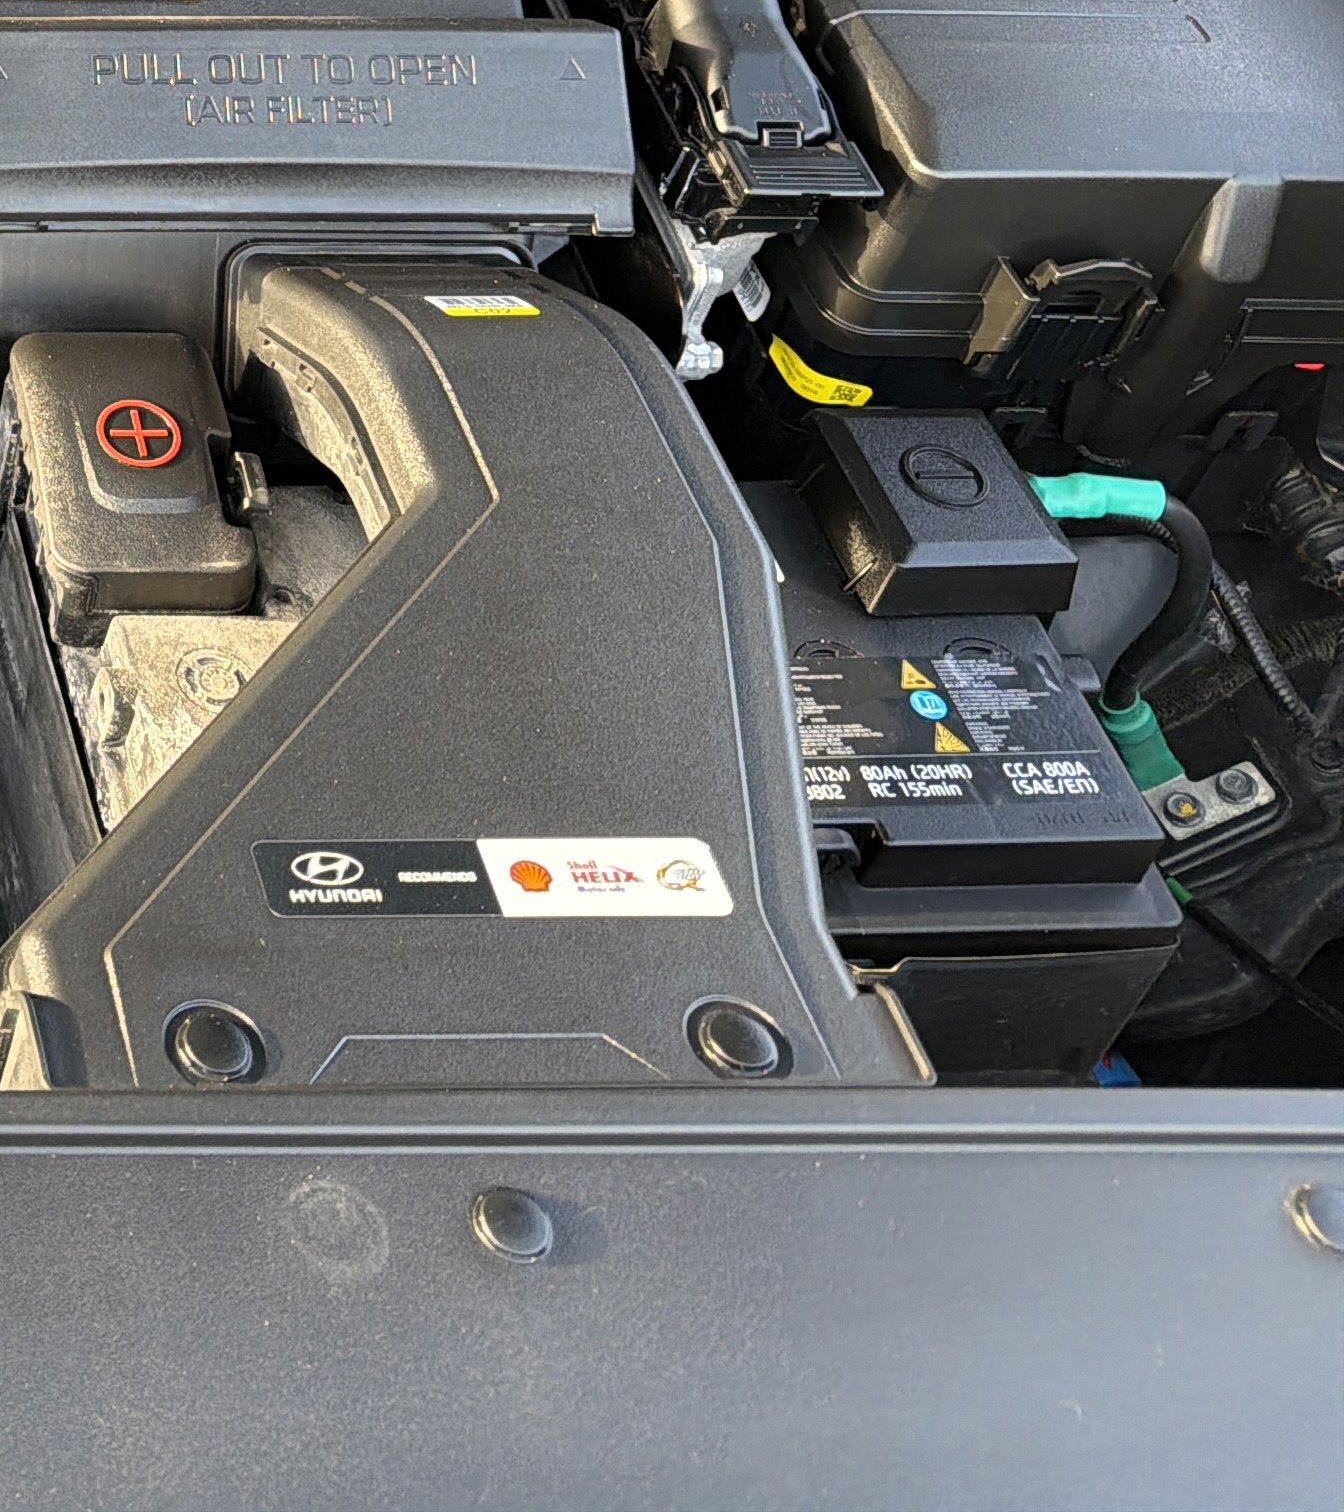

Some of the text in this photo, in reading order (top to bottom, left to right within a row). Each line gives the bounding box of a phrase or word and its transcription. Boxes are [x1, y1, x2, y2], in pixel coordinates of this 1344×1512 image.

[92, 53, 477, 87] PULL OUT TO OPEN
[859, 764, 909, 781] 80Ah
[910, 763, 973, 780] (20HR)
[1002, 761, 1043, 778] CCA
[1042, 760, 1091, 777] 800A
[868, 782, 897, 798] RC
[897, 781, 963, 797] 155min
[571, 870, 641, 883] HELIX
[289, 888, 383, 903] HYUNDAI
